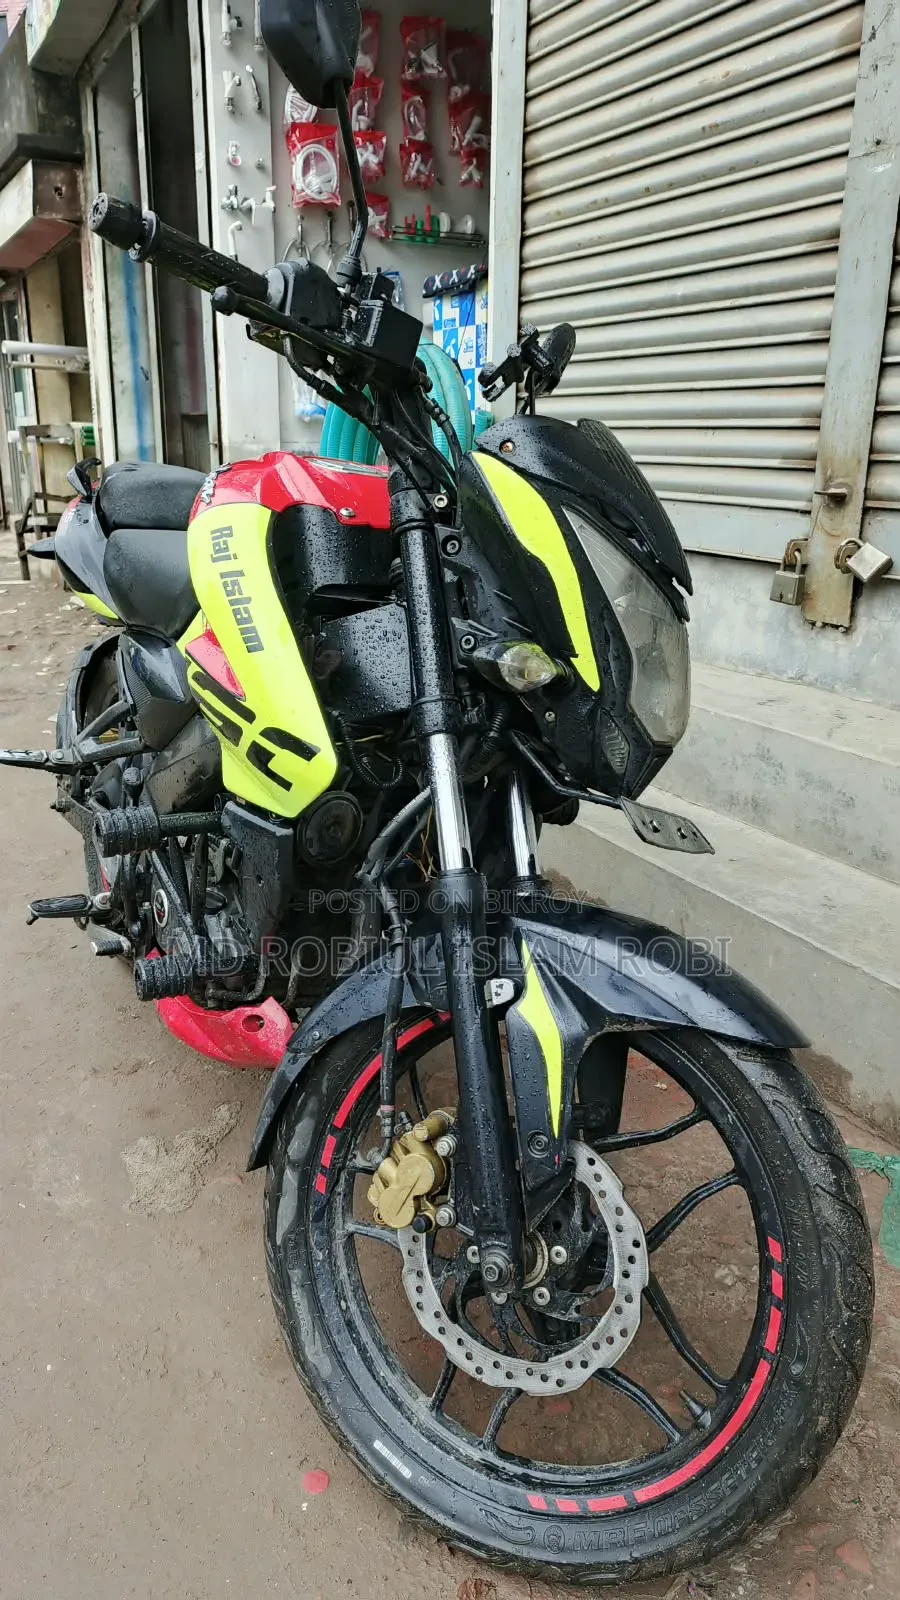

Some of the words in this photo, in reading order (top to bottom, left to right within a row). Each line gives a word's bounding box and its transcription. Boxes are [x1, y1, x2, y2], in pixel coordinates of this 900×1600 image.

[210, 525, 238, 564] Raj
[219, 568, 264, 654] Islam
[574, 1522, 649, 1551] MRF
